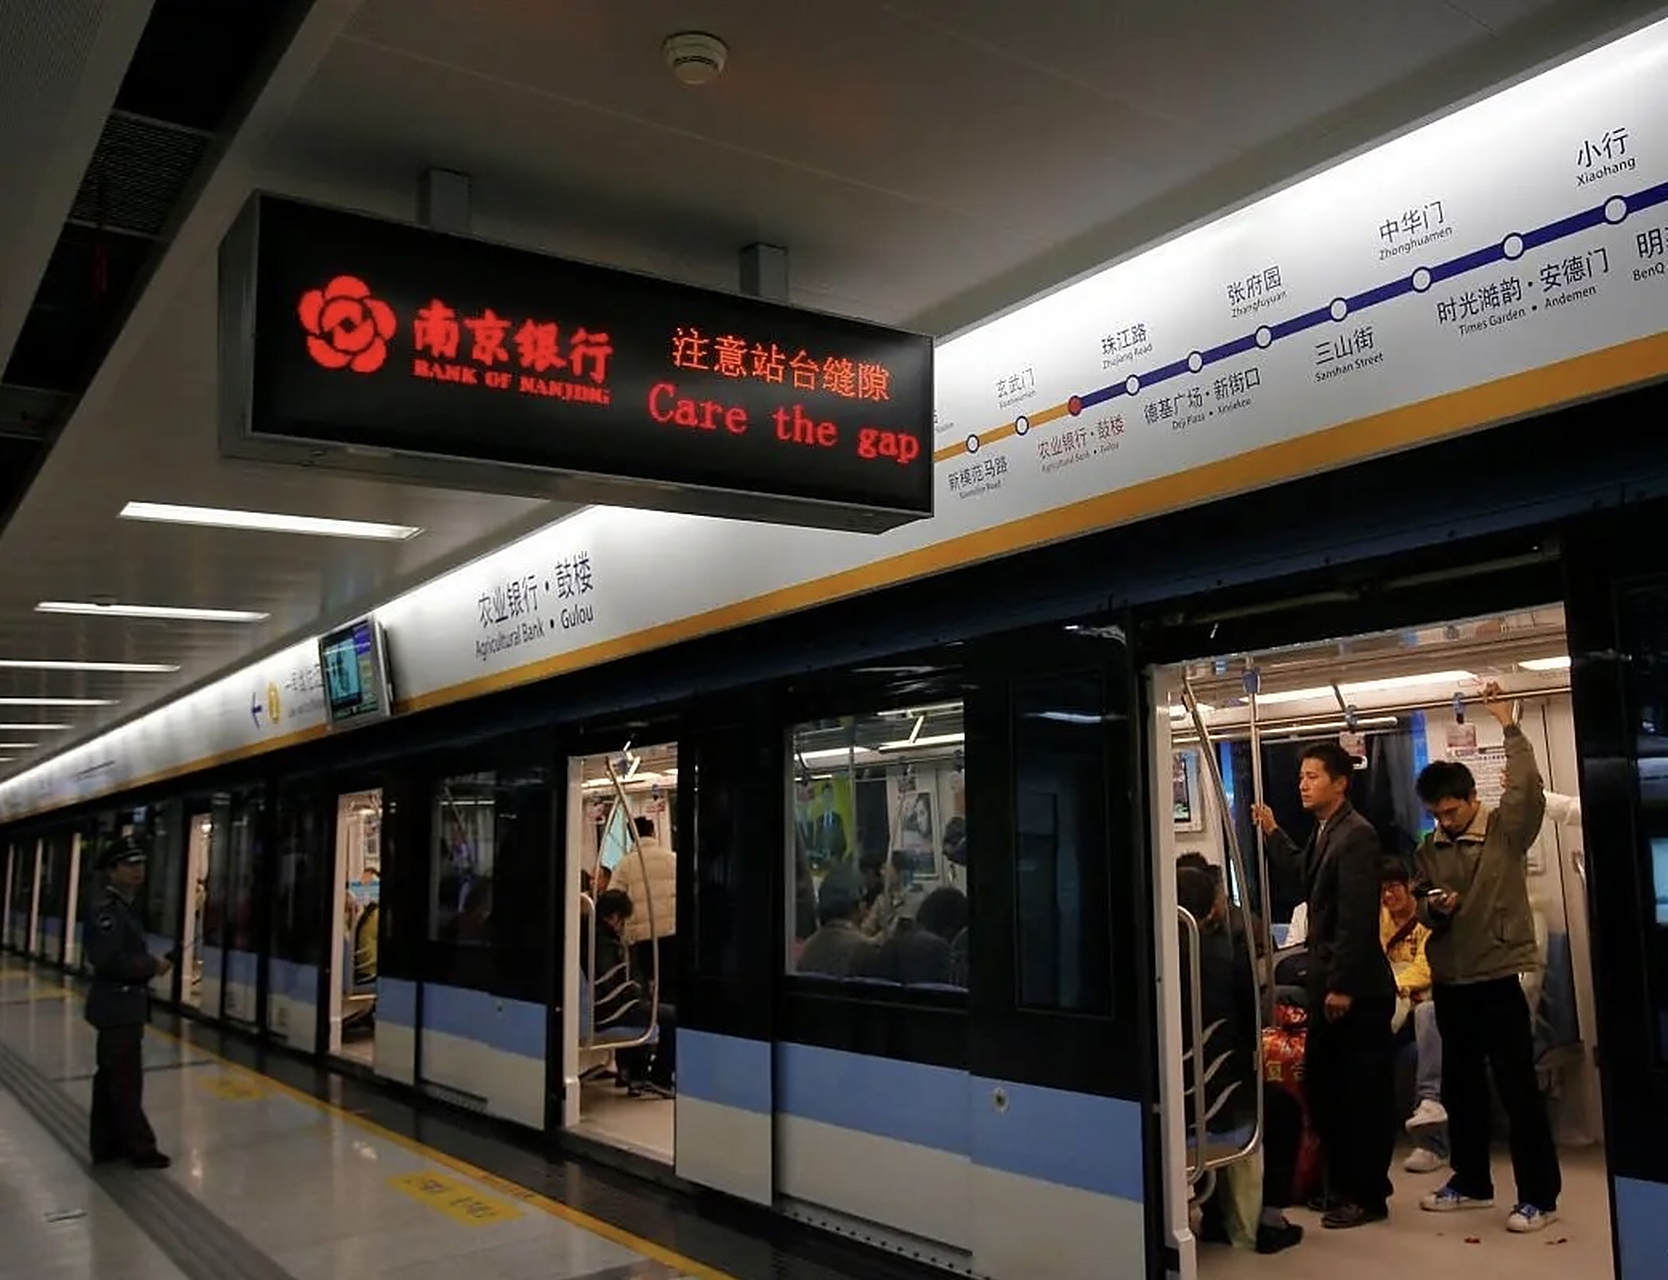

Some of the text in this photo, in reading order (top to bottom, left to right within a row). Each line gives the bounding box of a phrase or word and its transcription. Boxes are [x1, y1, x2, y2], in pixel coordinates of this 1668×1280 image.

[1577, 127, 1628, 167] 小行
[1576, 157, 1636, 187] Xiaohang
[1379, 201, 1444, 242] 中华门
[1379, 227, 1453, 260] Zhonghuamen
[1636, 227, 1668, 259] 明
[1226, 265, 1281, 306] 张府园
[1633, 261, 1665, 282] BenQ
[1459, 285, 1597, 336] Times Garden Andemen
[1101, 323, 1146, 355] 珠江路
[1315, 325, 1374, 365] 三山街
[413, 359, 610, 405] BANK OF NANJING
[672, 327, 890, 400] 注意站台缝隙
[1315, 352, 1384, 382] Sanshan Street
[648, 382, 920, 464] Care the gap
[522, 618, 545, 643] Bank
[561, 604, 594, 629] Gulou
